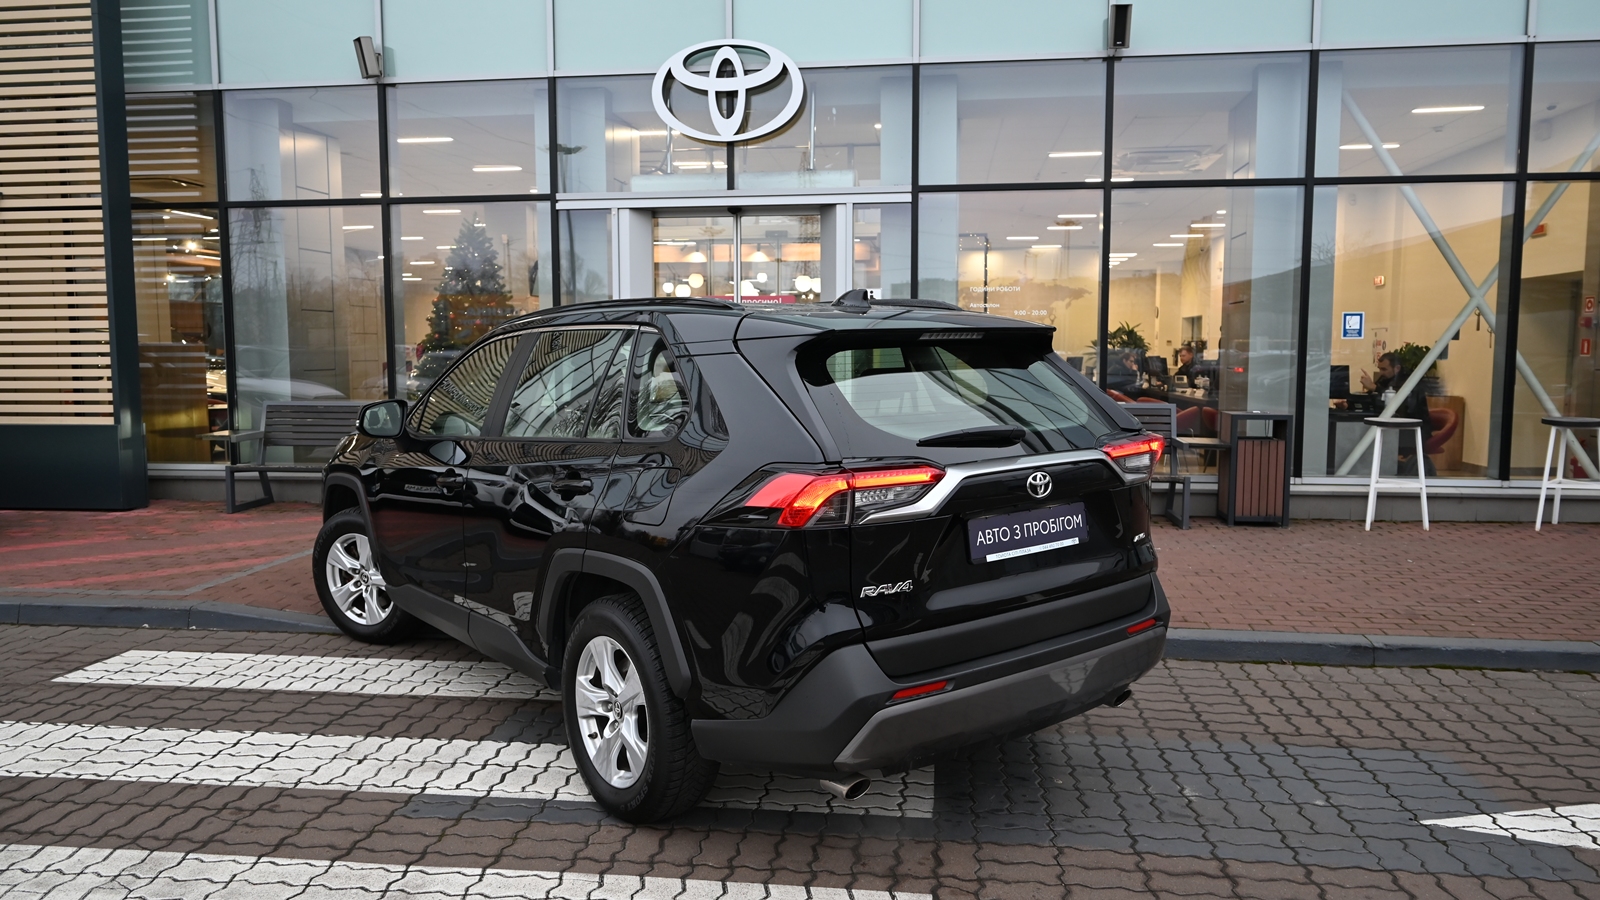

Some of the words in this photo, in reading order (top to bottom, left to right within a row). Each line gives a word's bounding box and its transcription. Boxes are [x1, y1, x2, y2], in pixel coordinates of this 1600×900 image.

[976, 526, 1011, 546] АВТО
[1023, 513, 1083, 537] ПРОБІГОМ
[859, 579, 914, 598] RAV4
